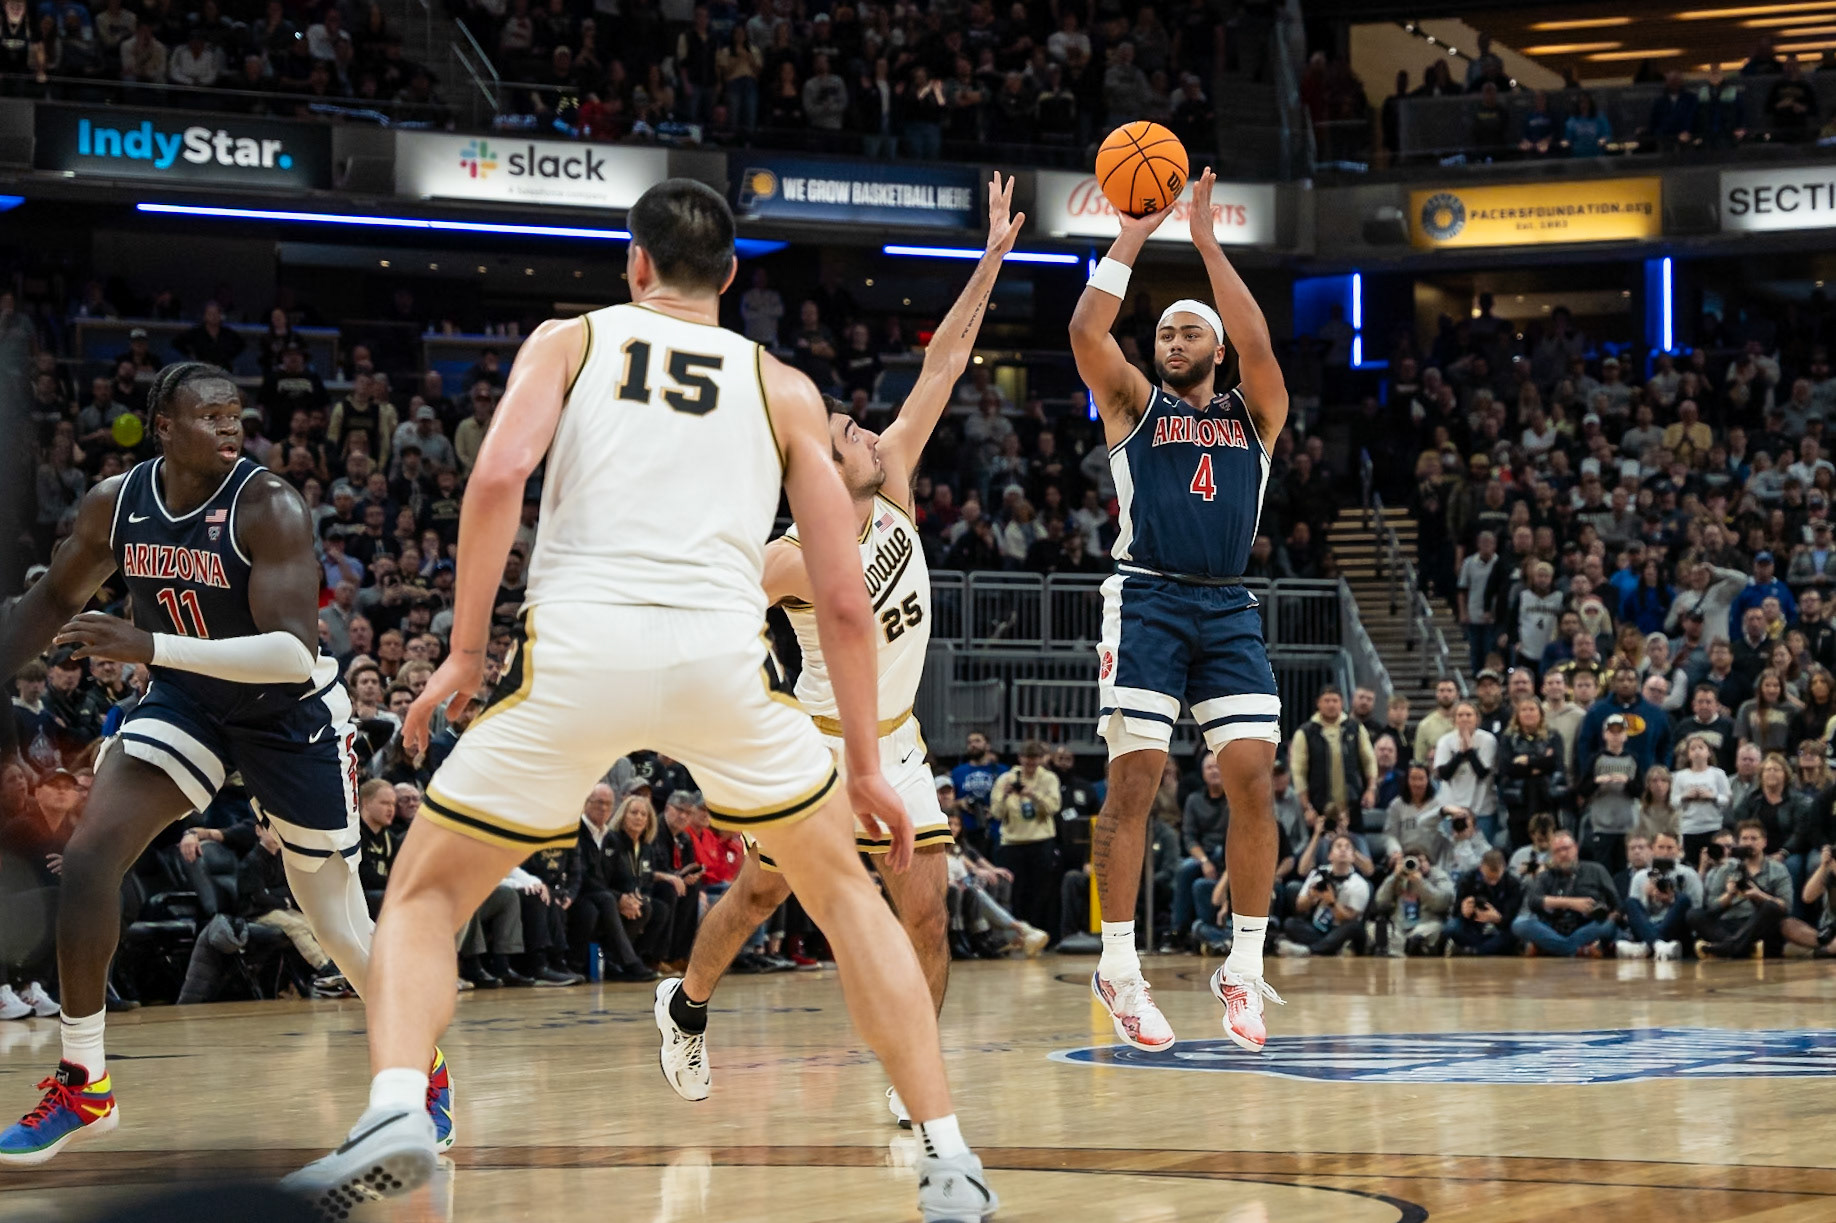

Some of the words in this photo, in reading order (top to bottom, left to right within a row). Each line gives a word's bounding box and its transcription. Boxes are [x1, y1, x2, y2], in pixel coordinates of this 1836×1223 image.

[77, 118, 293, 169] IndyStar.
[508, 145, 606, 181] slack
[782, 177, 806, 201] WE
[807, 178, 850, 204] GROW
[852, 181, 936, 209] BASKETBALL
[937, 186, 972, 210] HERE
[1729, 182, 1836, 215] SECTI
[614, 336, 725, 417] 15
[1189, 453, 1217, 501] 4
[124, 543, 231, 589] ARIZONA
[864, 527, 913, 600] urdue
[156, 587, 210, 639] 11
[880, 590, 923, 644] 25
